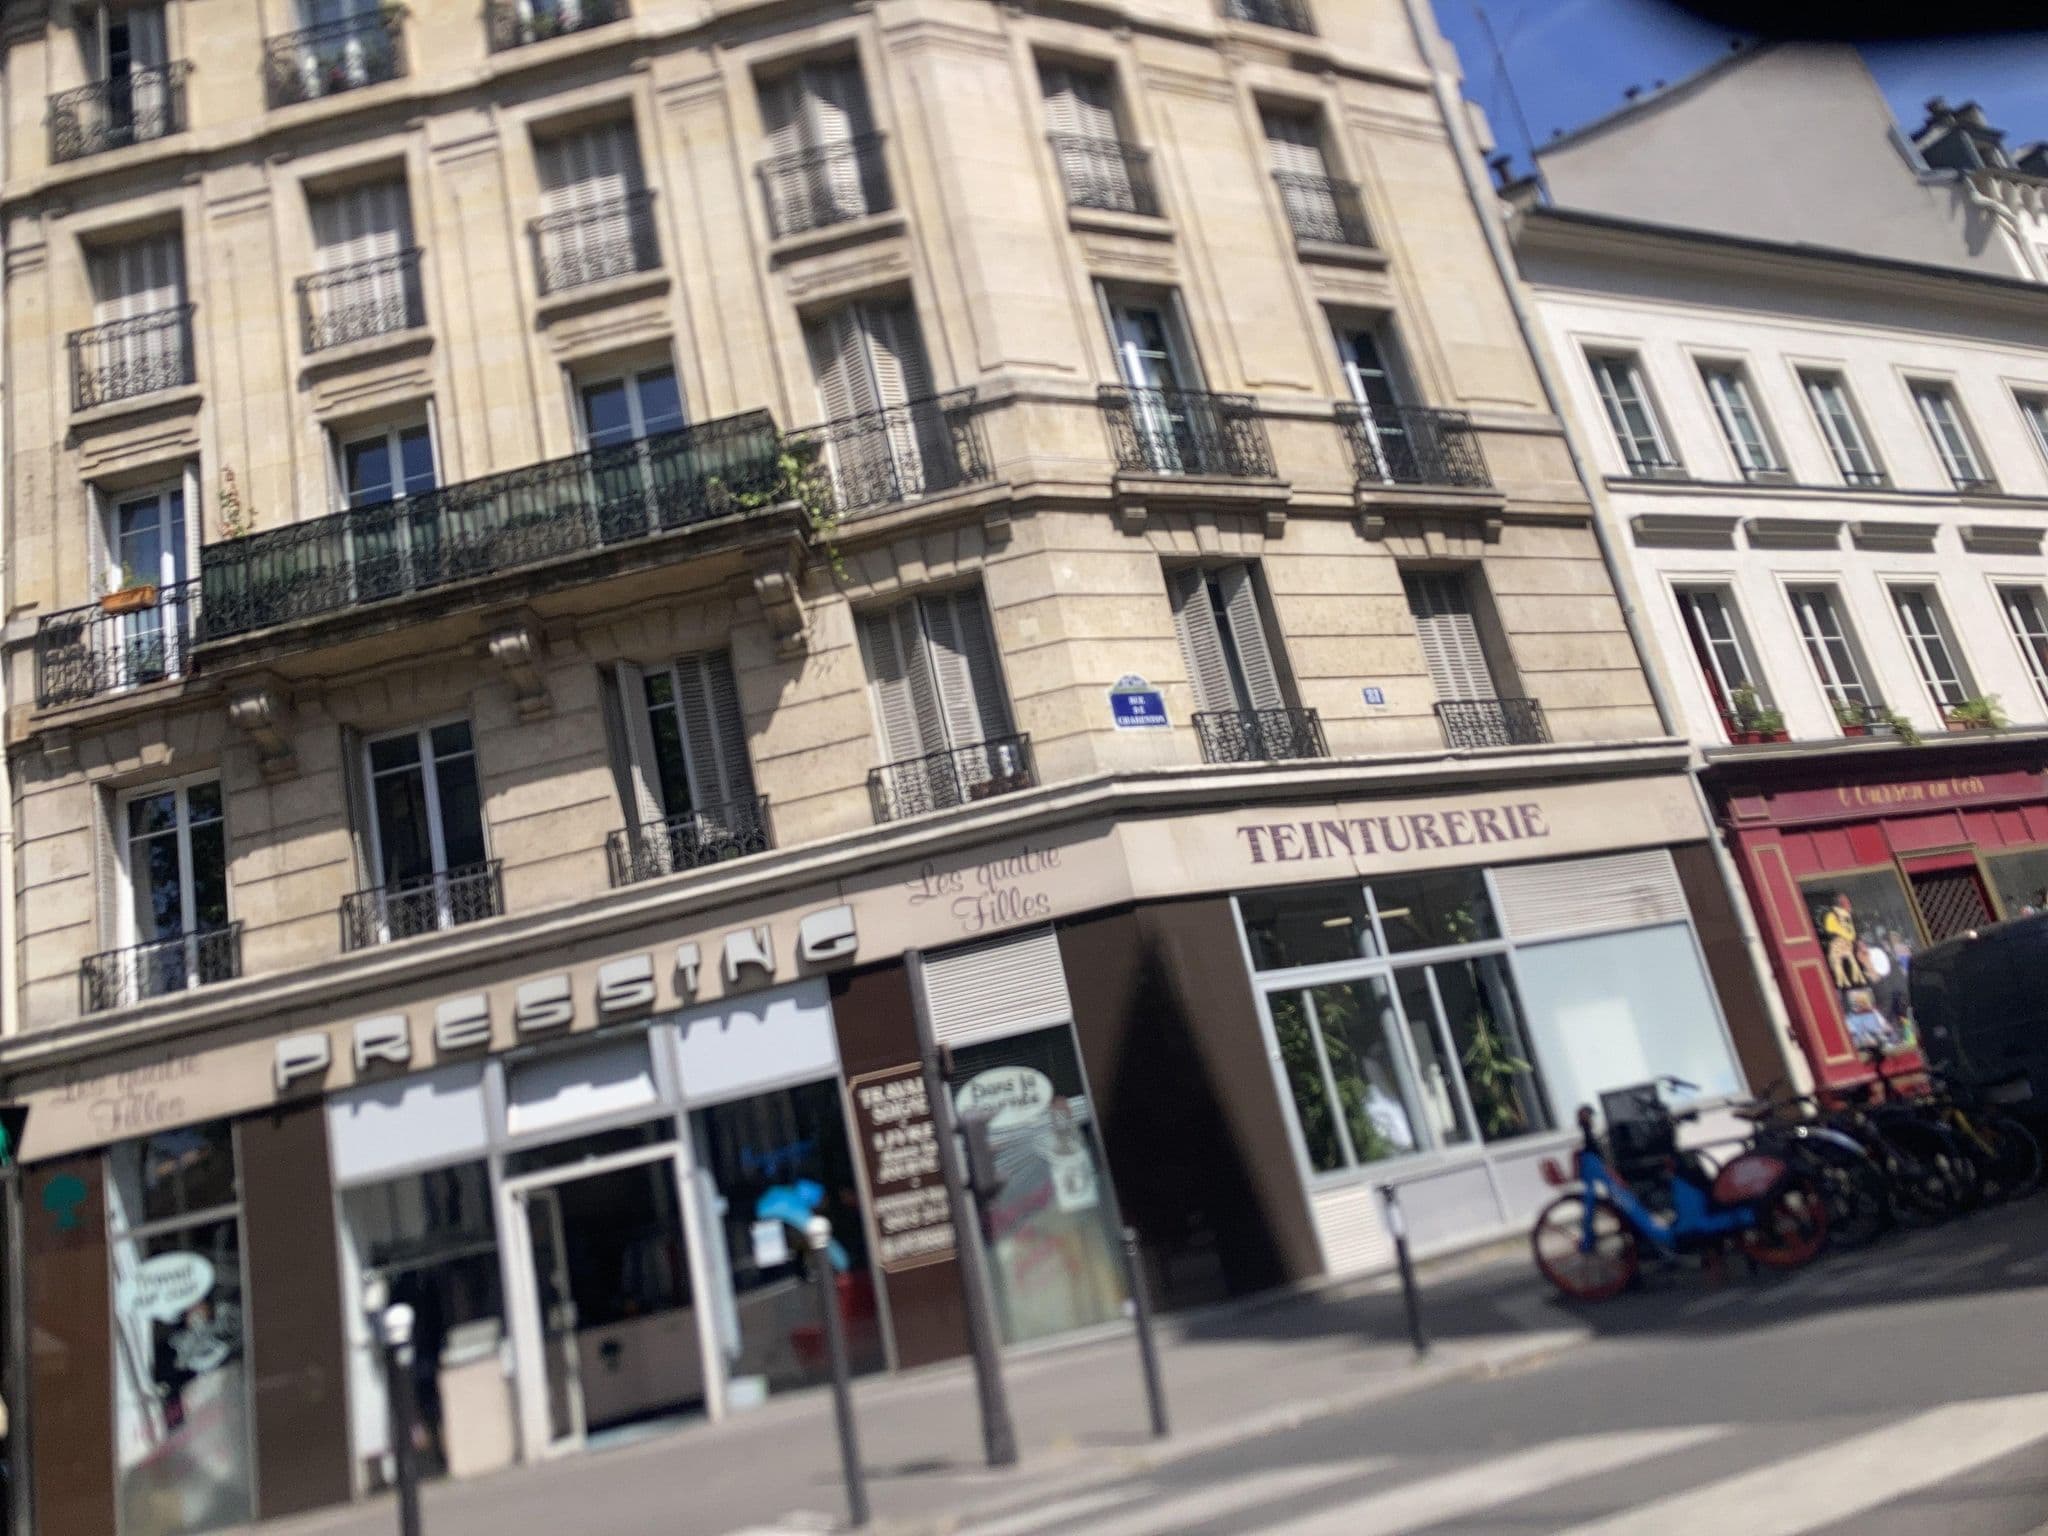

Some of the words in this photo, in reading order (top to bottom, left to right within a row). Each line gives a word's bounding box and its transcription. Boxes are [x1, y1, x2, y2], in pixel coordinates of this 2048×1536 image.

[1237, 802, 1550, 864] TEINTURERIE
[904, 861, 965, 905] Les
[976, 845, 1063, 894] quatre
[951, 886, 1052, 934] Filles
[274, 904, 859, 1090] PRESSING
